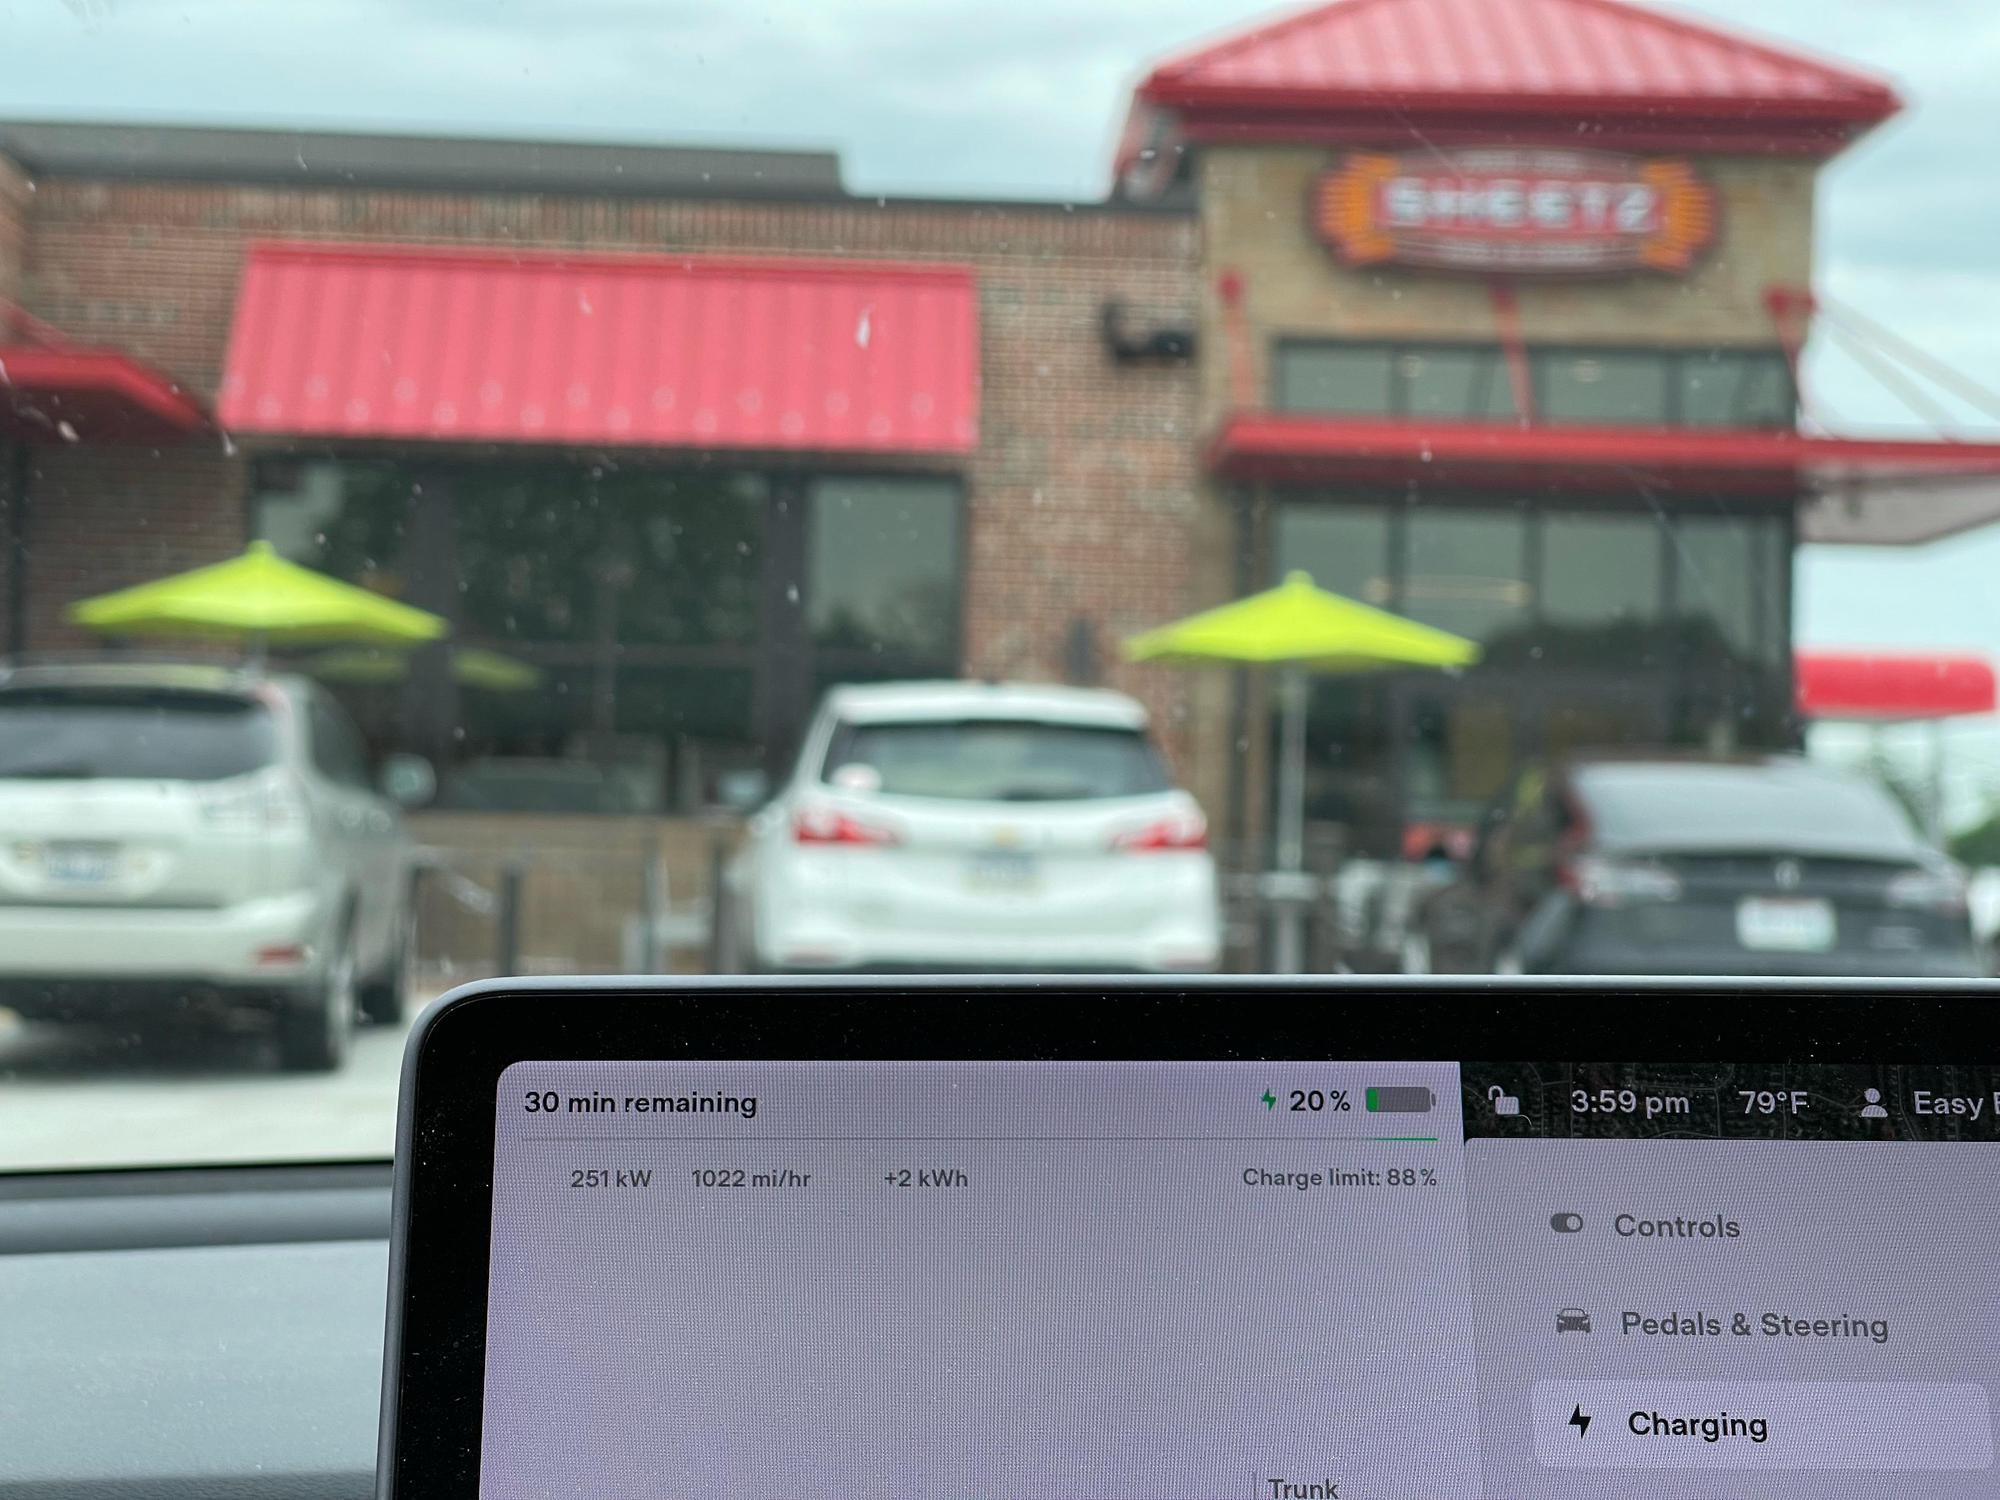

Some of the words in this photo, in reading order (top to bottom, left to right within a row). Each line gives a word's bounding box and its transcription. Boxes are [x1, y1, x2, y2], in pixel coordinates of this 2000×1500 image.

[524, 1092, 560, 1113] 30
[568, 1091, 616, 1113] min
[625, 1091, 757, 1119] remaining
[1571, 1090, 1637, 1113] 3:59
[1645, 1094, 1690, 1119] pm
[1740, 1090, 1808, 1115] 79°F
[1914, 1091, 1984, 1120] Easy
[571, 1170, 608, 1188] 251
[616, 1170, 652, 1188] kW
[692, 1170, 746, 1188] 1022
[752, 1169, 811, 1188] mi/hr
[884, 1170, 912, 1188] +2
[919, 1169, 968, 1188] kWh
[1243, 1168, 1322, 1190] Charge
[1329, 1168, 1380, 1186] limit:
[1614, 1213, 1741, 1239] Controls
[1621, 1311, 1720, 1336] Pedals
[1730, 1313, 1752, 1336] &
[1761, 1313, 1889, 1343] Steering
[1628, 1411, 1768, 1443] Charging
[1268, 1478, 1339, 1499] Trunk
